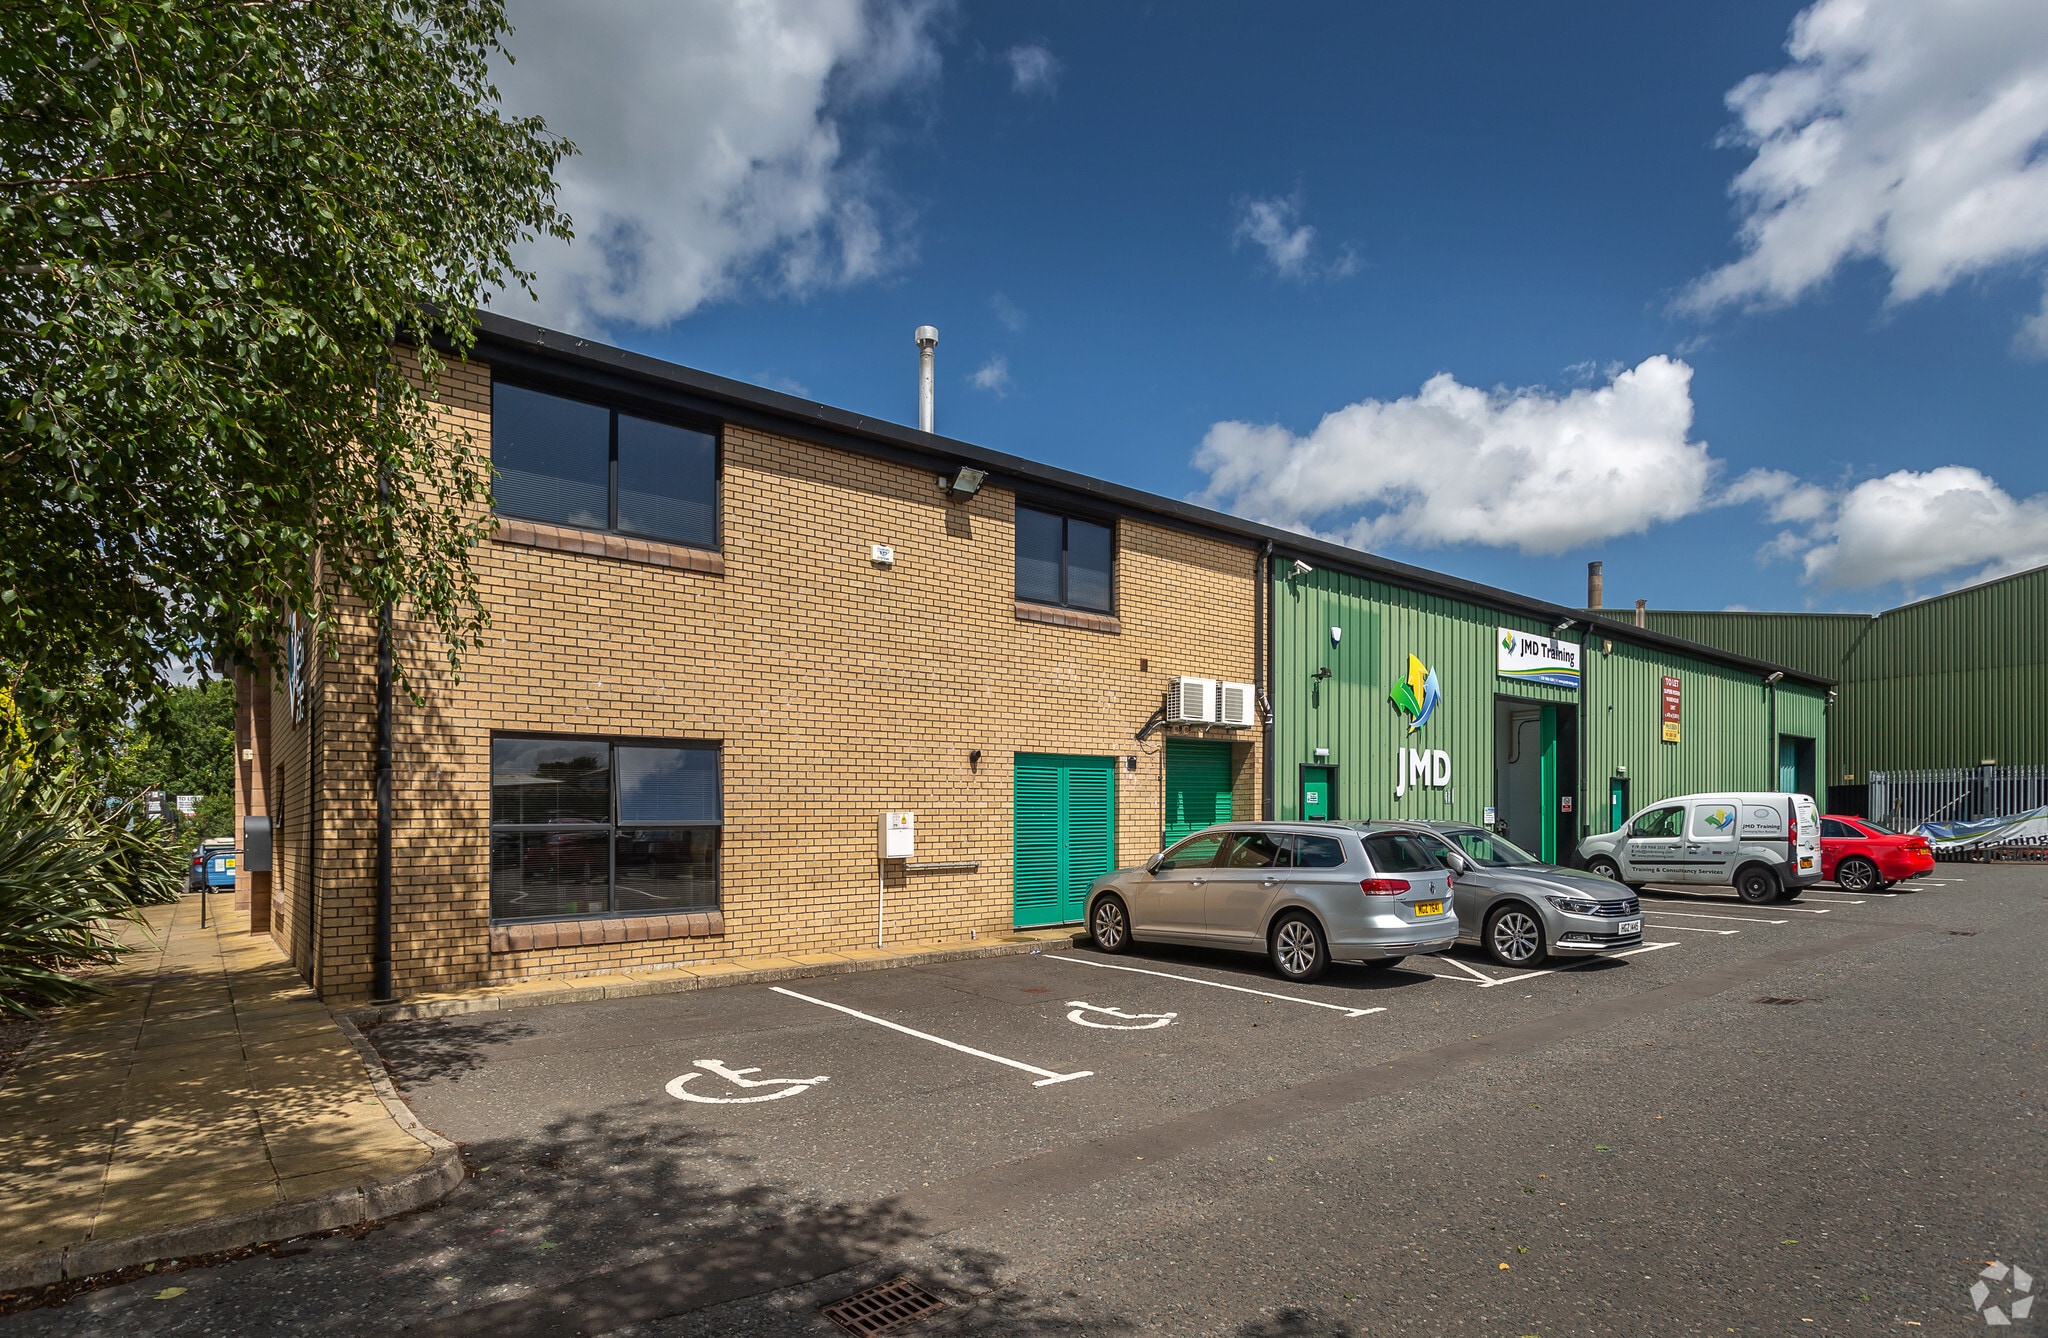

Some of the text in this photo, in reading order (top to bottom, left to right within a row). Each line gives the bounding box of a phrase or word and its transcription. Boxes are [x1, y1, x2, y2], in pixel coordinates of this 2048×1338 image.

[1520, 638, 1575, 668] JMD Training
[1665, 677, 1672, 686] TO
[1396, 747, 1452, 797] JMD
[1662, 867, 1697, 875] Consultancy
